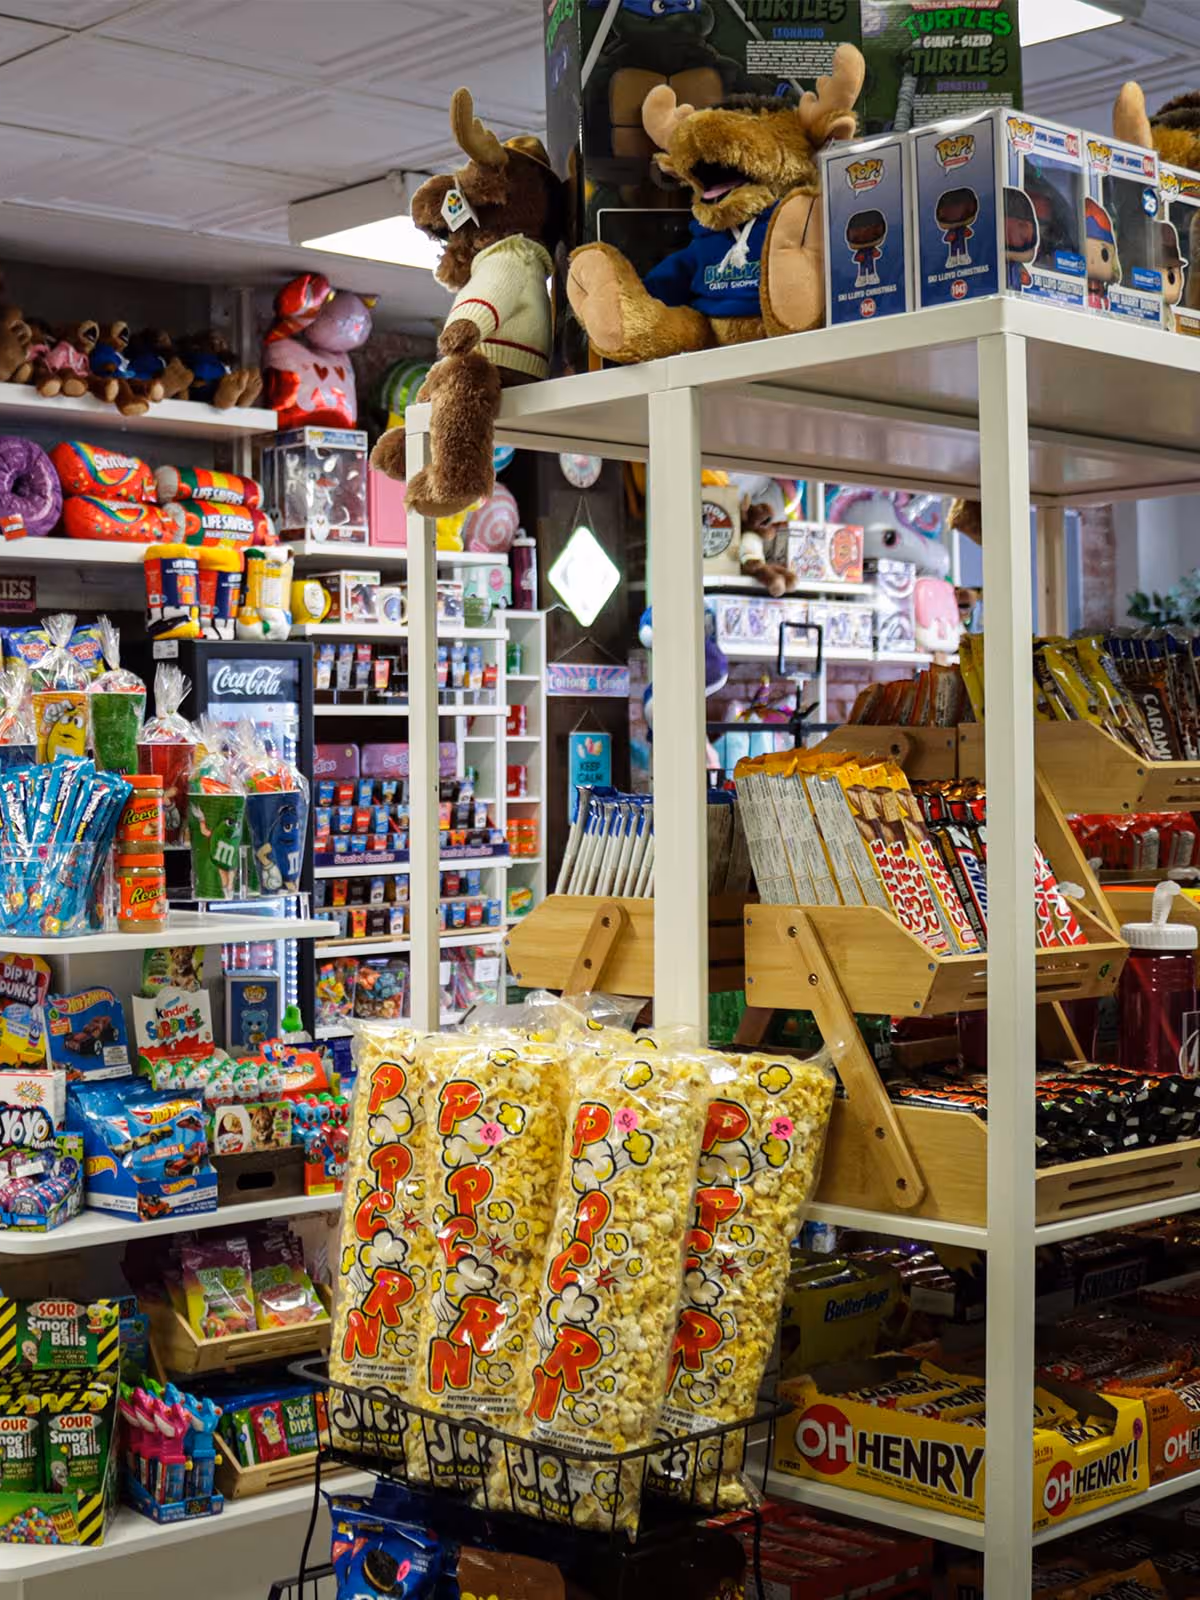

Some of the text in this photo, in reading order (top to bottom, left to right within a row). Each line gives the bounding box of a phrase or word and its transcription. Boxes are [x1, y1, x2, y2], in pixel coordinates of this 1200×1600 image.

[902, 7, 1013, 38] TURTLES
[912, 50, 1010, 76] TURTLES
[212, 665, 284, 696] Coca-Cola
[3, 965, 20, 981] DIP
[0, 979, 37, 1002] DUNKS
[39, 1302, 77, 1317] SOUR
[27, 1317, 70, 1337] Smog
[51, 1319, 88, 1347] Balls
[58, 1413, 93, 1429] SOUR
[287, 1404, 312, 1420] SOUR
[289, 1418, 314, 1435] DIPS
[6, 1434, 38, 1459] Balls
[50, 1430, 87, 1448] Smog
[1163, 1429, 1190, 1464] OH
[796, 1418, 855, 1463] OH
[857, 1430, 984, 1499] HENRY
[1043, 1468, 1074, 1510] OH
[1074, 1438, 1140, 1495] HENRY!
